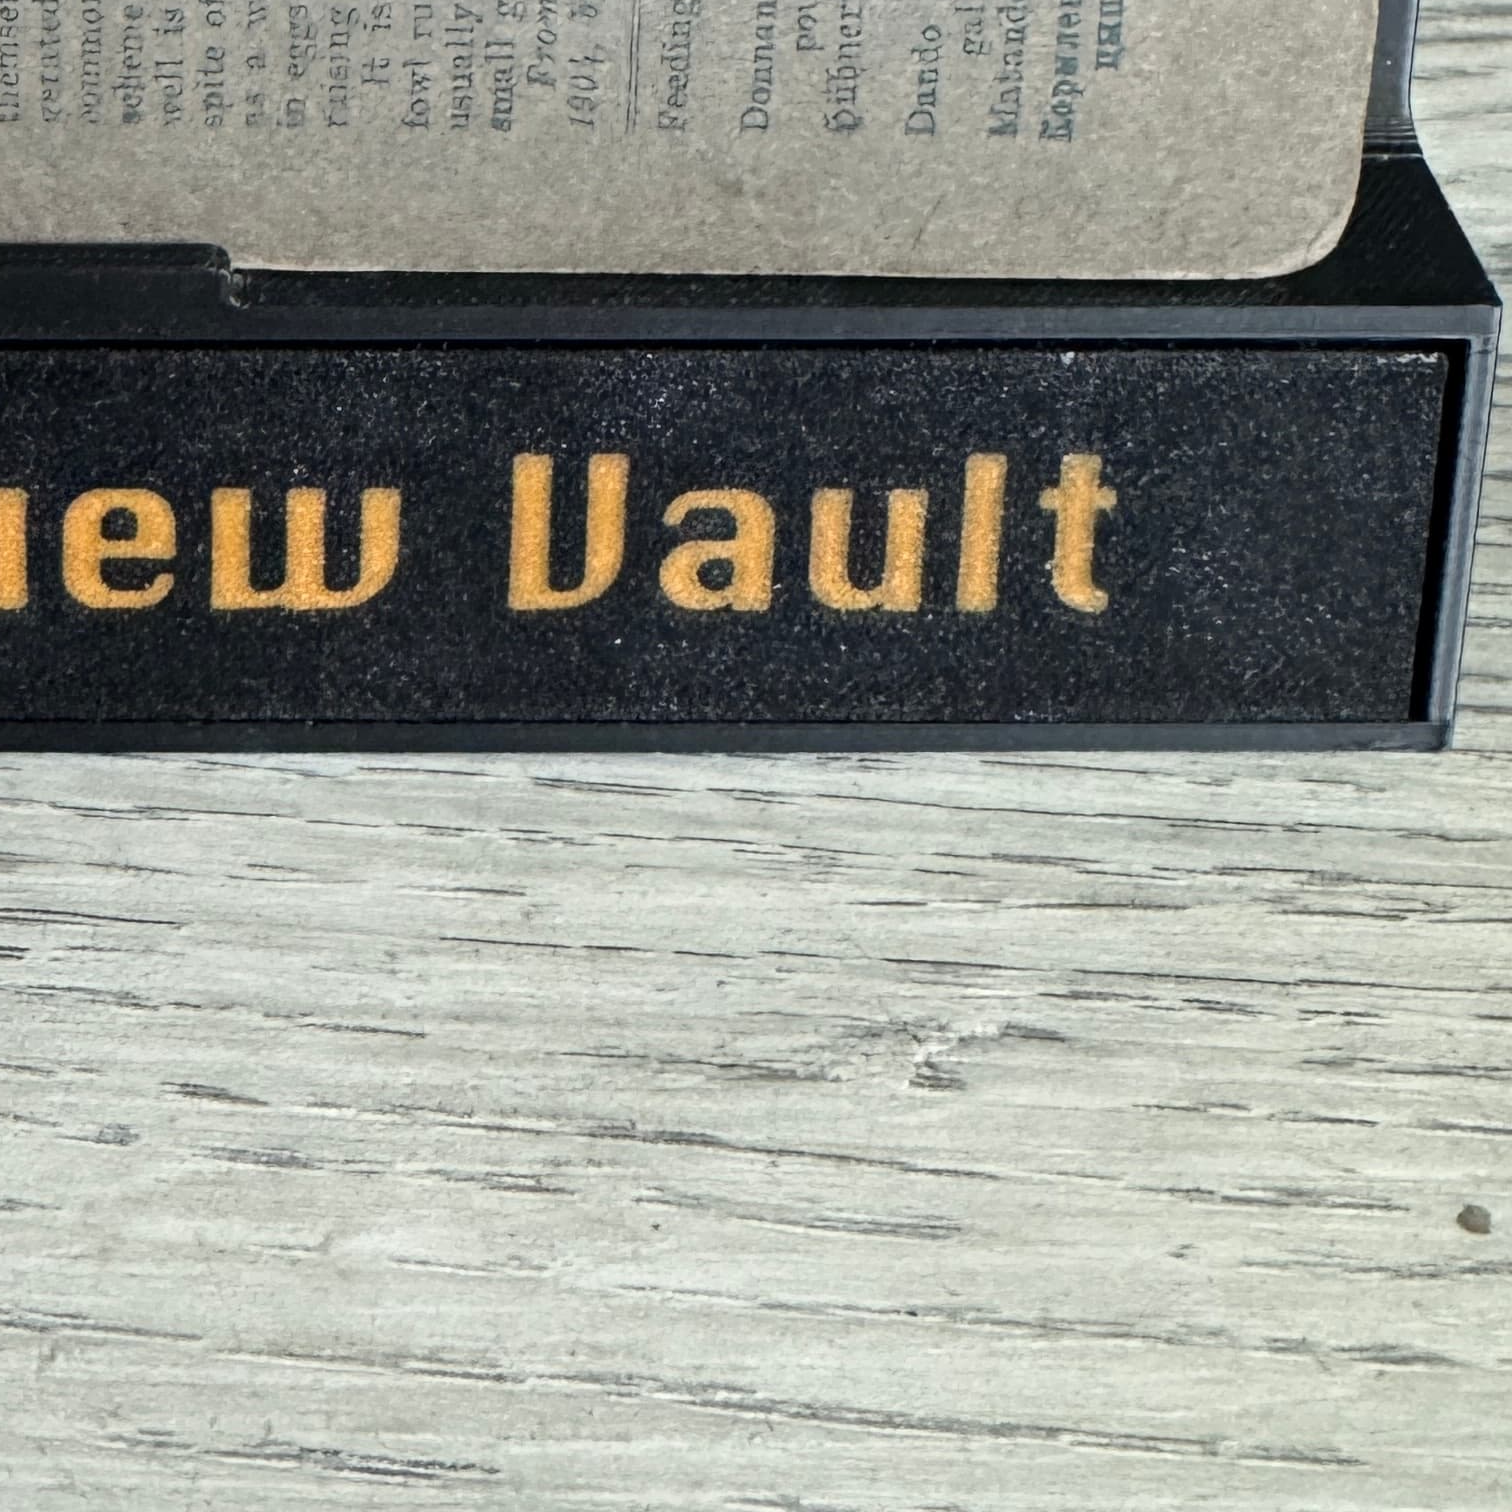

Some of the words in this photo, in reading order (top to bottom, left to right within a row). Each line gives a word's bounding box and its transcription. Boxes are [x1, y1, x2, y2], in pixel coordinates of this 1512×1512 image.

[155, 9, 182, 34] is
[288, 7, 313, 78] eggs
[364, 5, 390, 30] is
[363, 58, 389, 85] It
[403, 60, 432, 129] fowl
[444, 4, 482, 129] usually
[905, 26, 941, 135] Dando
[507, 452, 1118, 612] Vault
